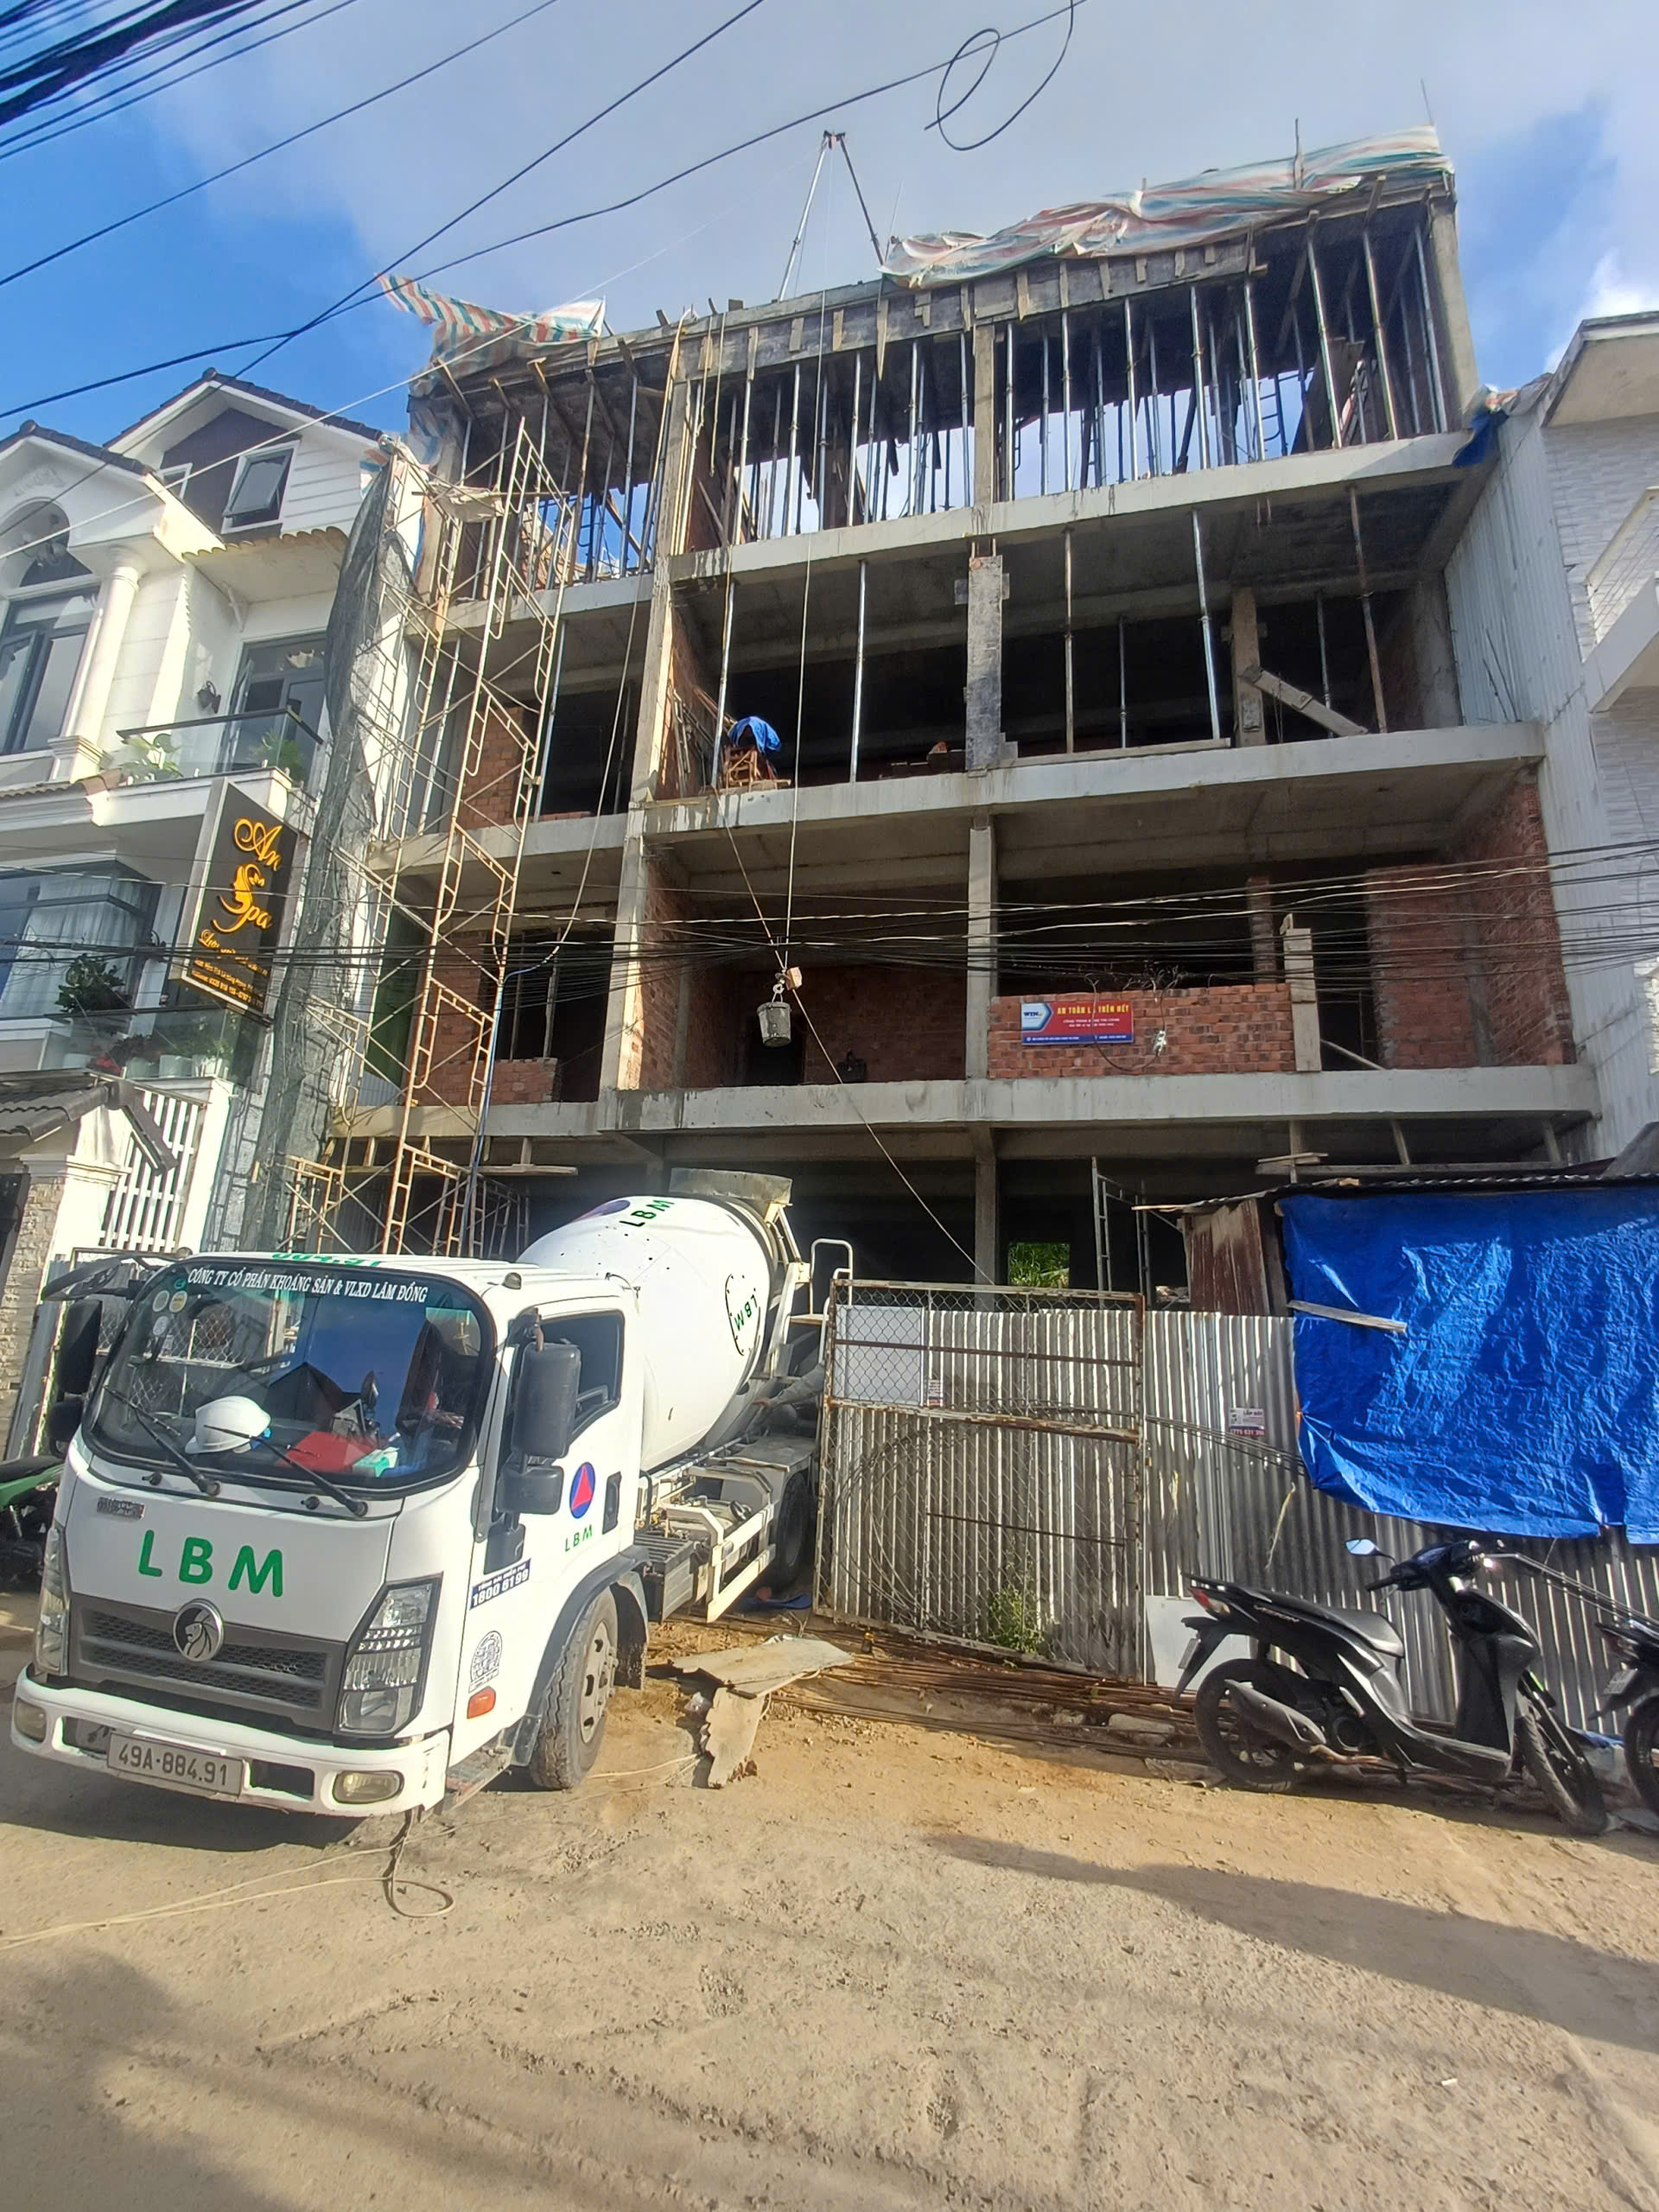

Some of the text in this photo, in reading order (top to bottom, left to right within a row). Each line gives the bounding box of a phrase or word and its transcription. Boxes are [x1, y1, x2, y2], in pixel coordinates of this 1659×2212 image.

[234, 818, 282, 871] An
[213, 863, 272, 933] Spa
[1068, 1005, 1085, 1014] TOÀN
[1098, 1004, 1115, 1013] TRÊN
[1116, 1003, 1129, 1013] HẾT
[619, 1199, 675, 1228] LBM
[188, 1268, 215, 1285] CÔNG
[213, 1270, 230, 1285] TY
[270, 1273, 312, 1292] KHOÁNG
[333, 1279, 344, 1295] &
[344, 1281, 372, 1298] VLXD
[564, 1524, 594, 1553] LBM
[138, 1529, 283, 1598] LBM
[473, 1582, 500, 1607] 1800
